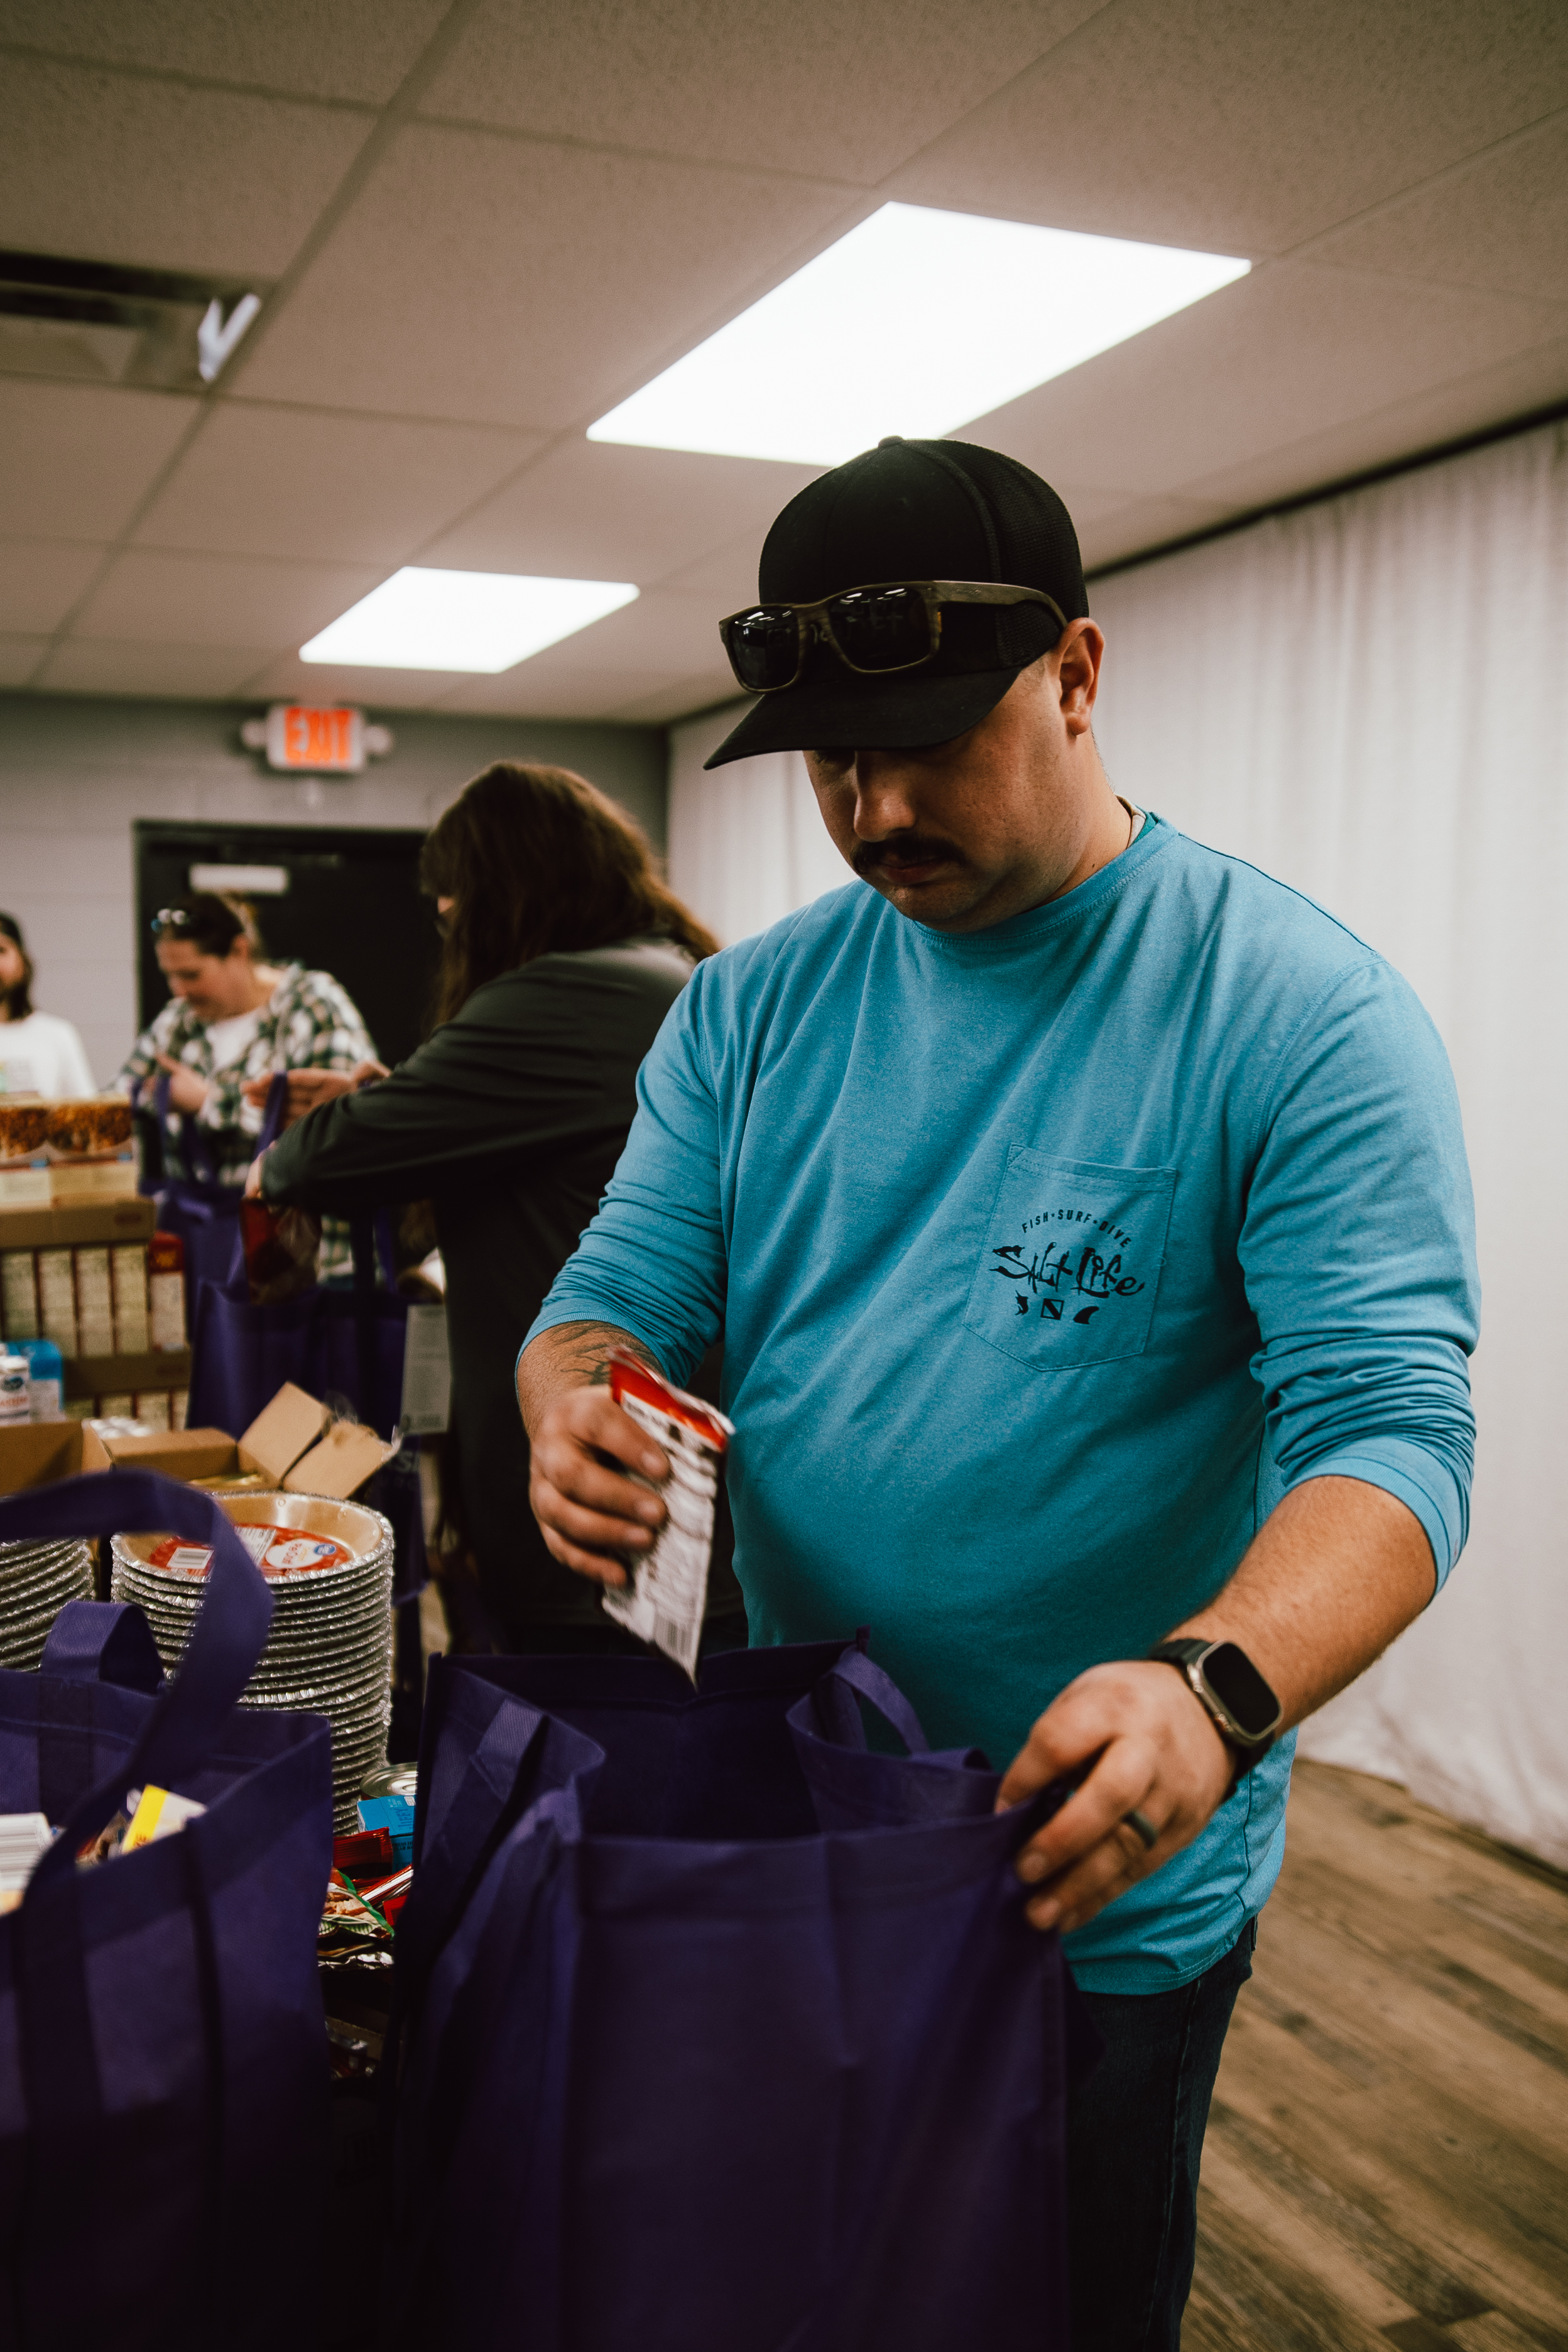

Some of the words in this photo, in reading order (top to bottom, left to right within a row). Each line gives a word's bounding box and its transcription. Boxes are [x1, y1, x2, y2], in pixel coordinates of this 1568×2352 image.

[1021, 1211, 1049, 1233] FISH
[1057, 1209, 1092, 1224] SURF
[1098, 1219, 1132, 1248] DIVE
